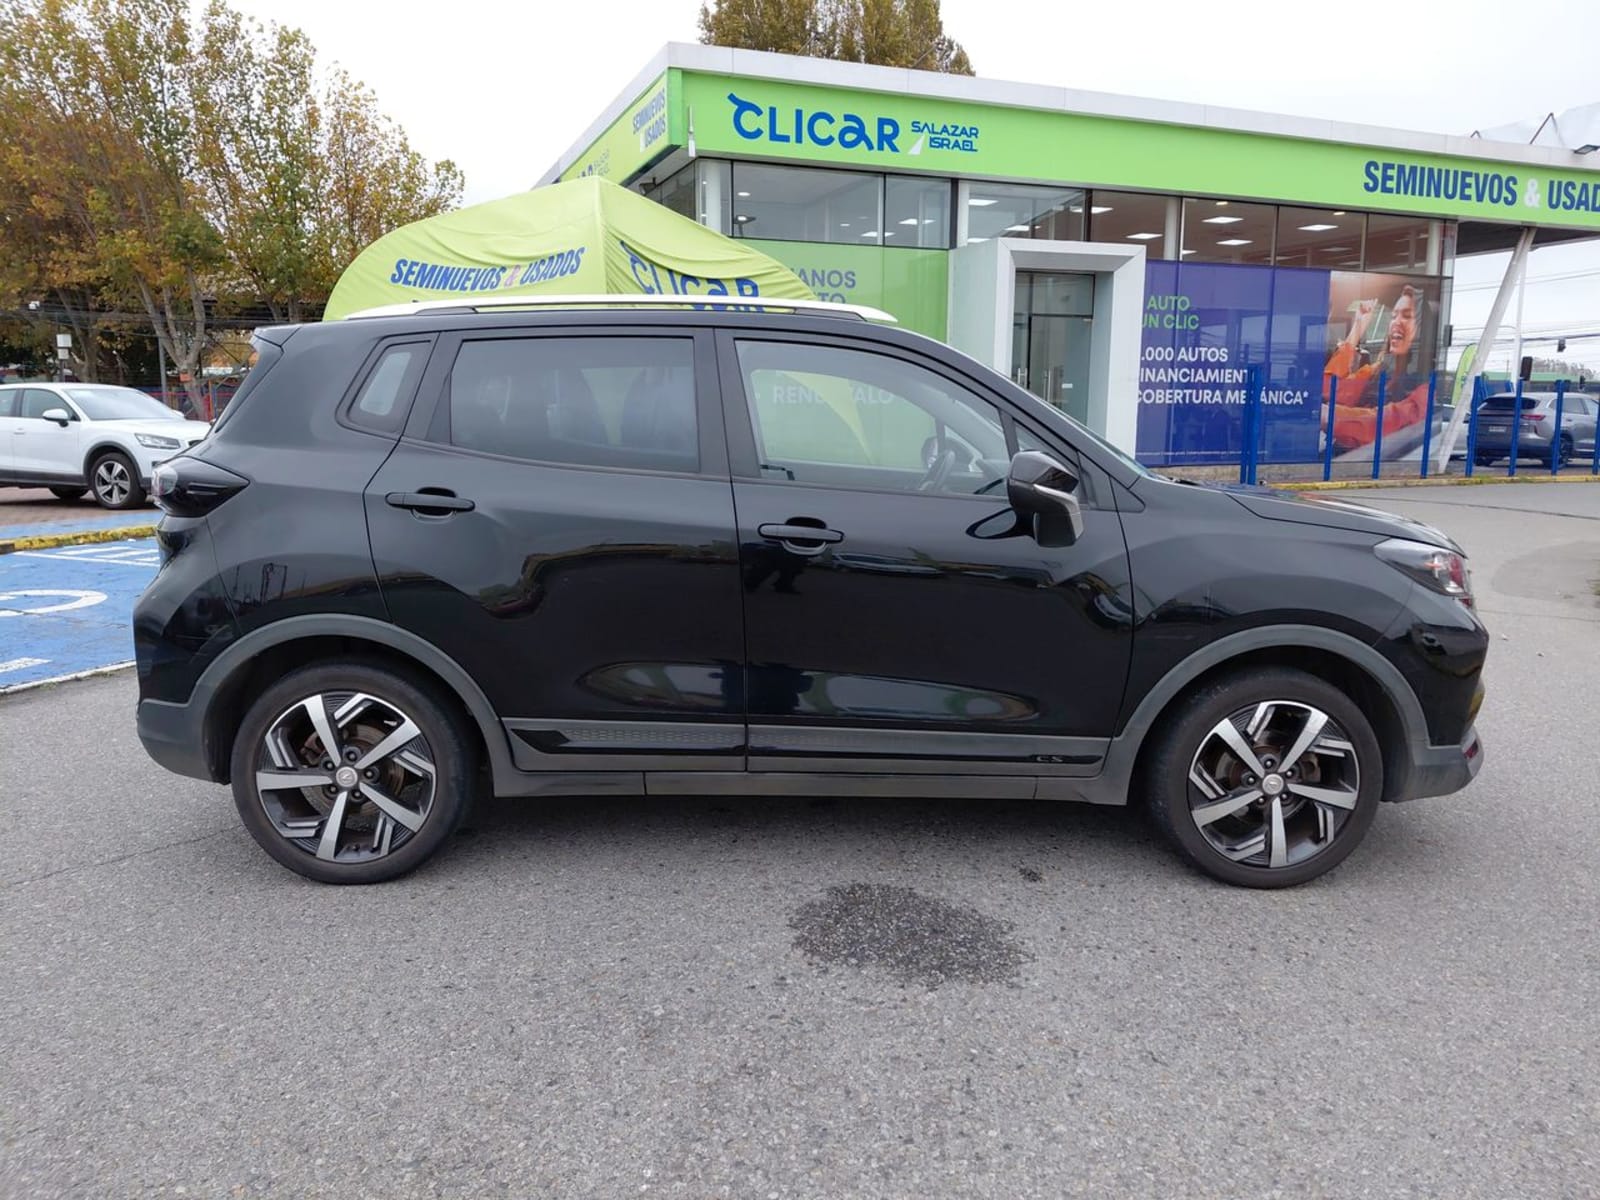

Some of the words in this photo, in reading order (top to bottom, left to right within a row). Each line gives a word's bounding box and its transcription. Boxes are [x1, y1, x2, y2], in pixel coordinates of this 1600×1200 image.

[911, 120, 979, 139] SALAZAR
[929, 136, 979, 152] ISRAEL
[1363, 160, 1518, 206] SEMINUEVOS
[1524, 178, 1541, 208] &
[390, 258, 507, 292] SEMINUEVOS
[519, 247, 586, 285] USADOS
[790, 267, 856, 288] ANOS
[1146, 295, 1190, 311] AUTO
[1163, 314, 1199, 330] CLIC
[1177, 347, 1228, 362] AUTOS
